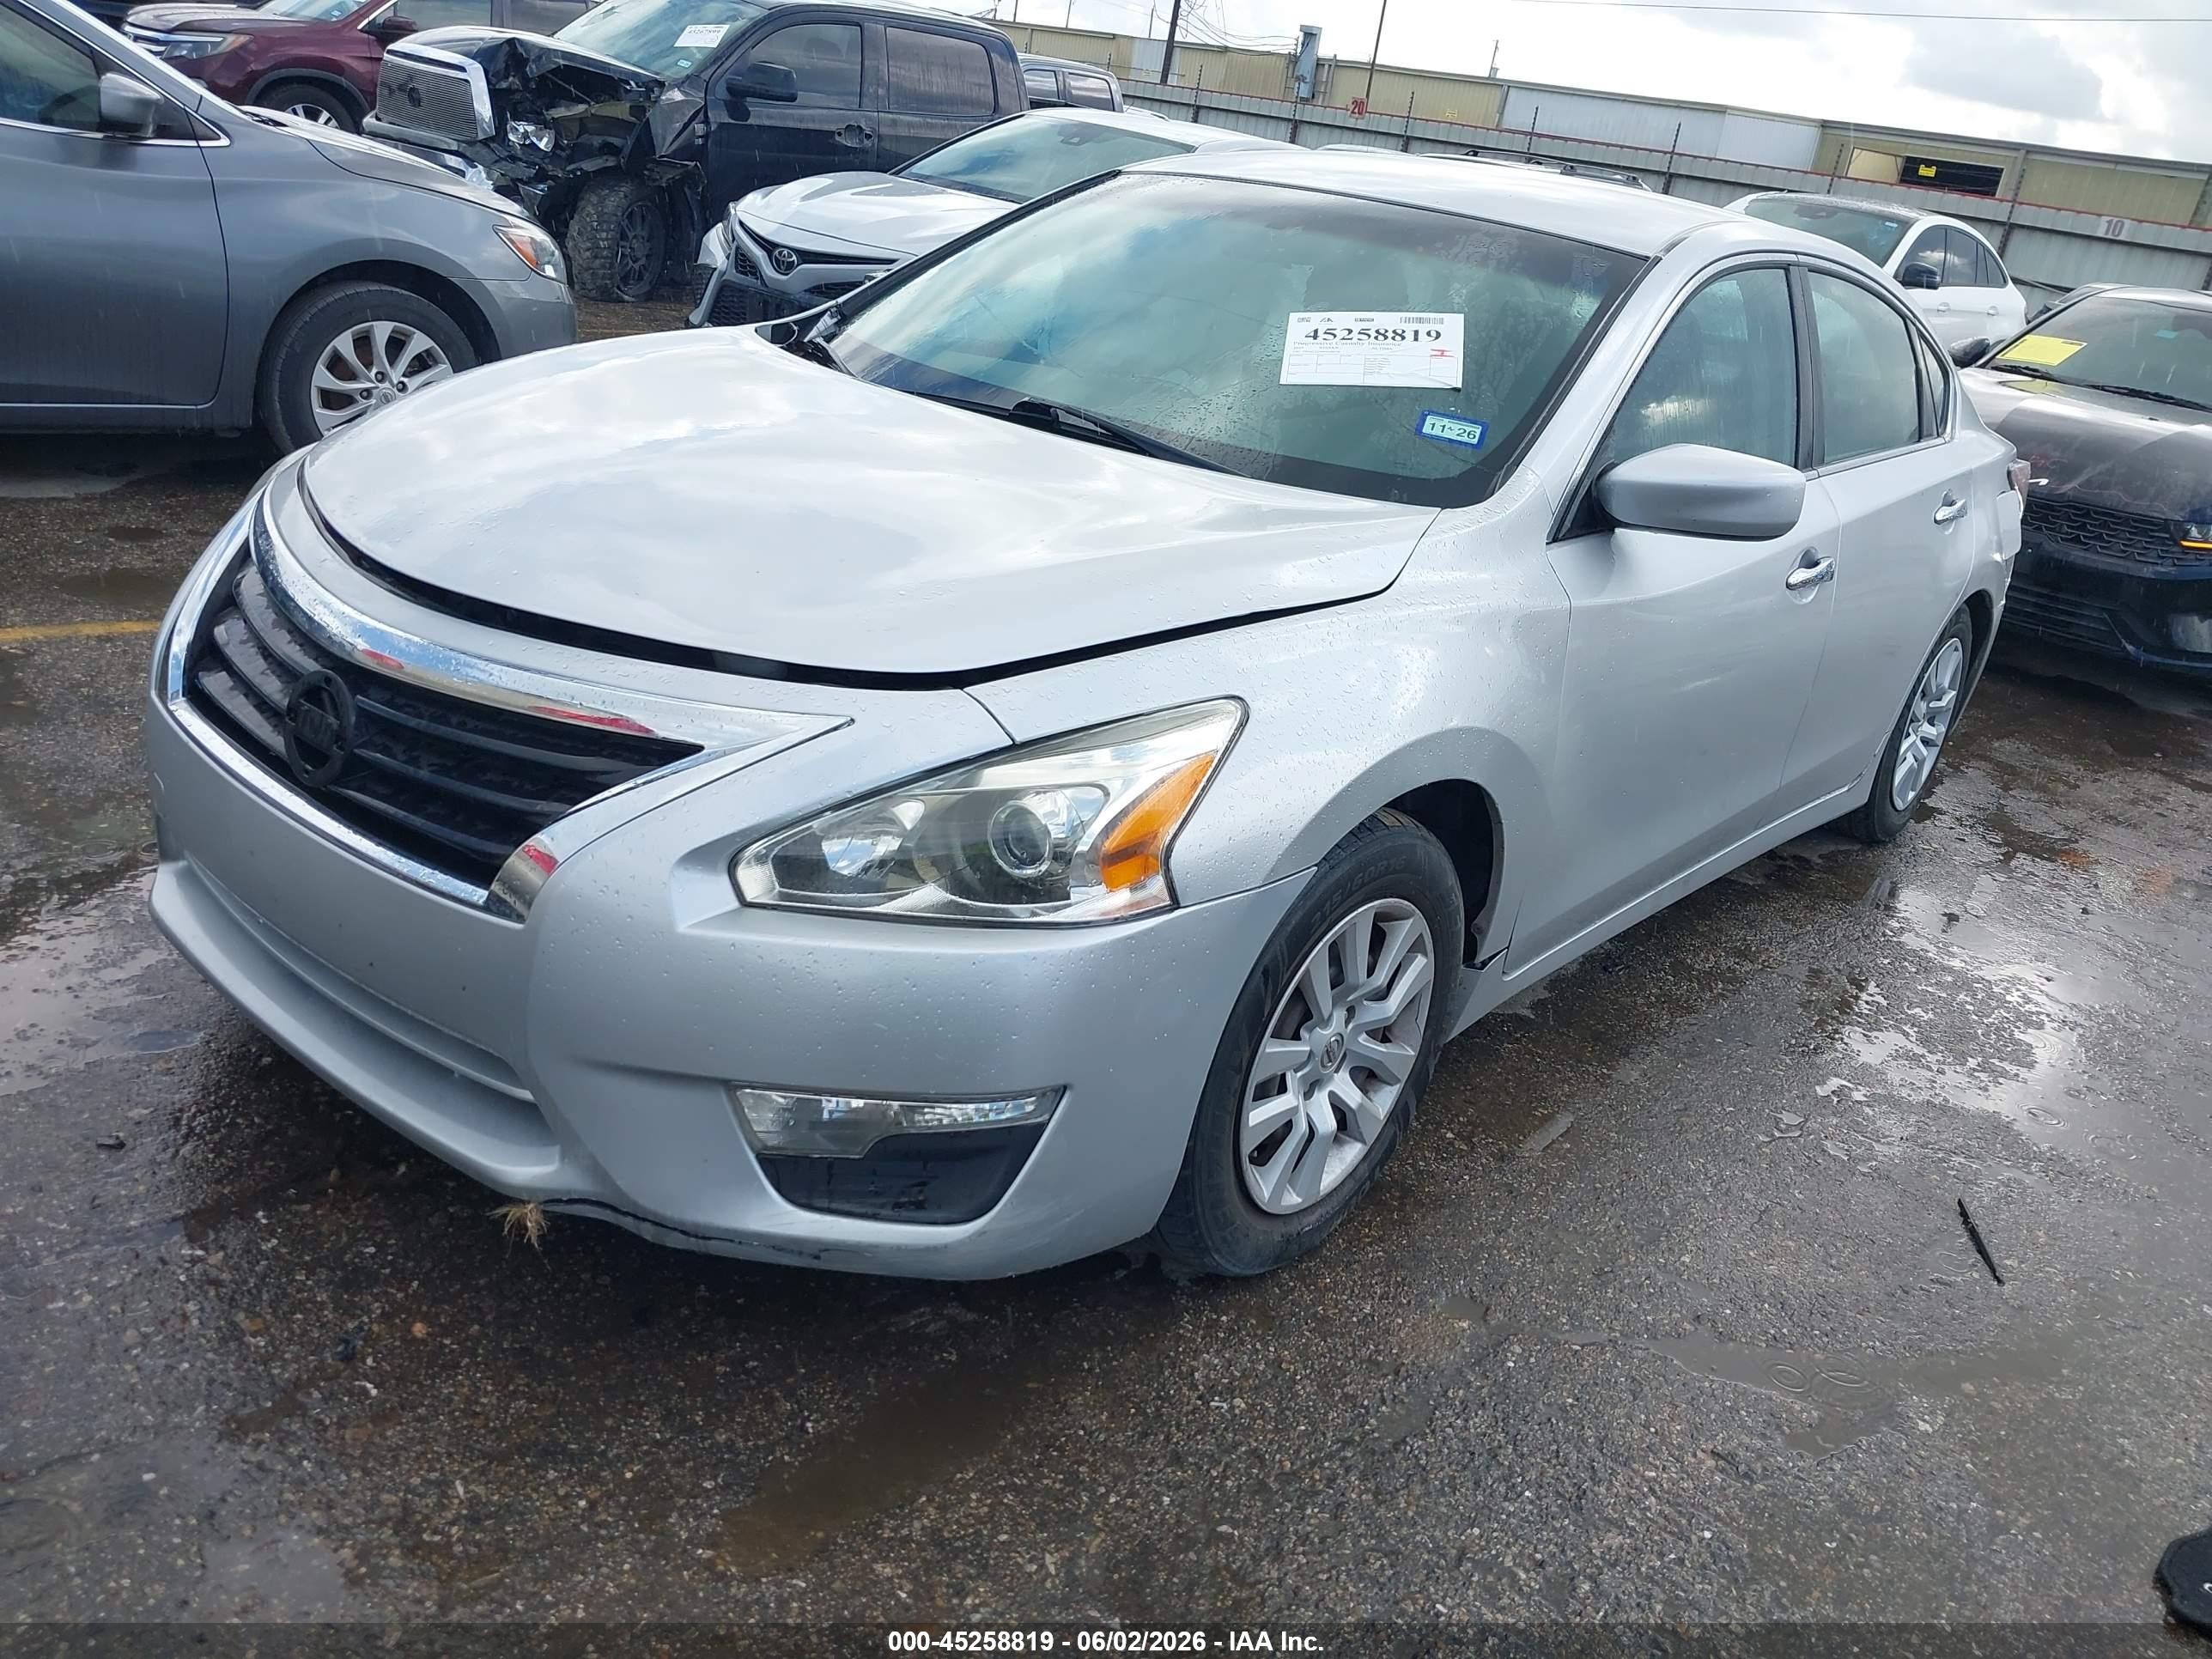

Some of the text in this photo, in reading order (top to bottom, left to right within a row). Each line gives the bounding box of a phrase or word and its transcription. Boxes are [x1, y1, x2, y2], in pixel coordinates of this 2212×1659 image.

[1351, 100, 1365, 115] 20
[2104, 219, 2125, 237] 10
[1304, 328, 1442, 342] 45258819
